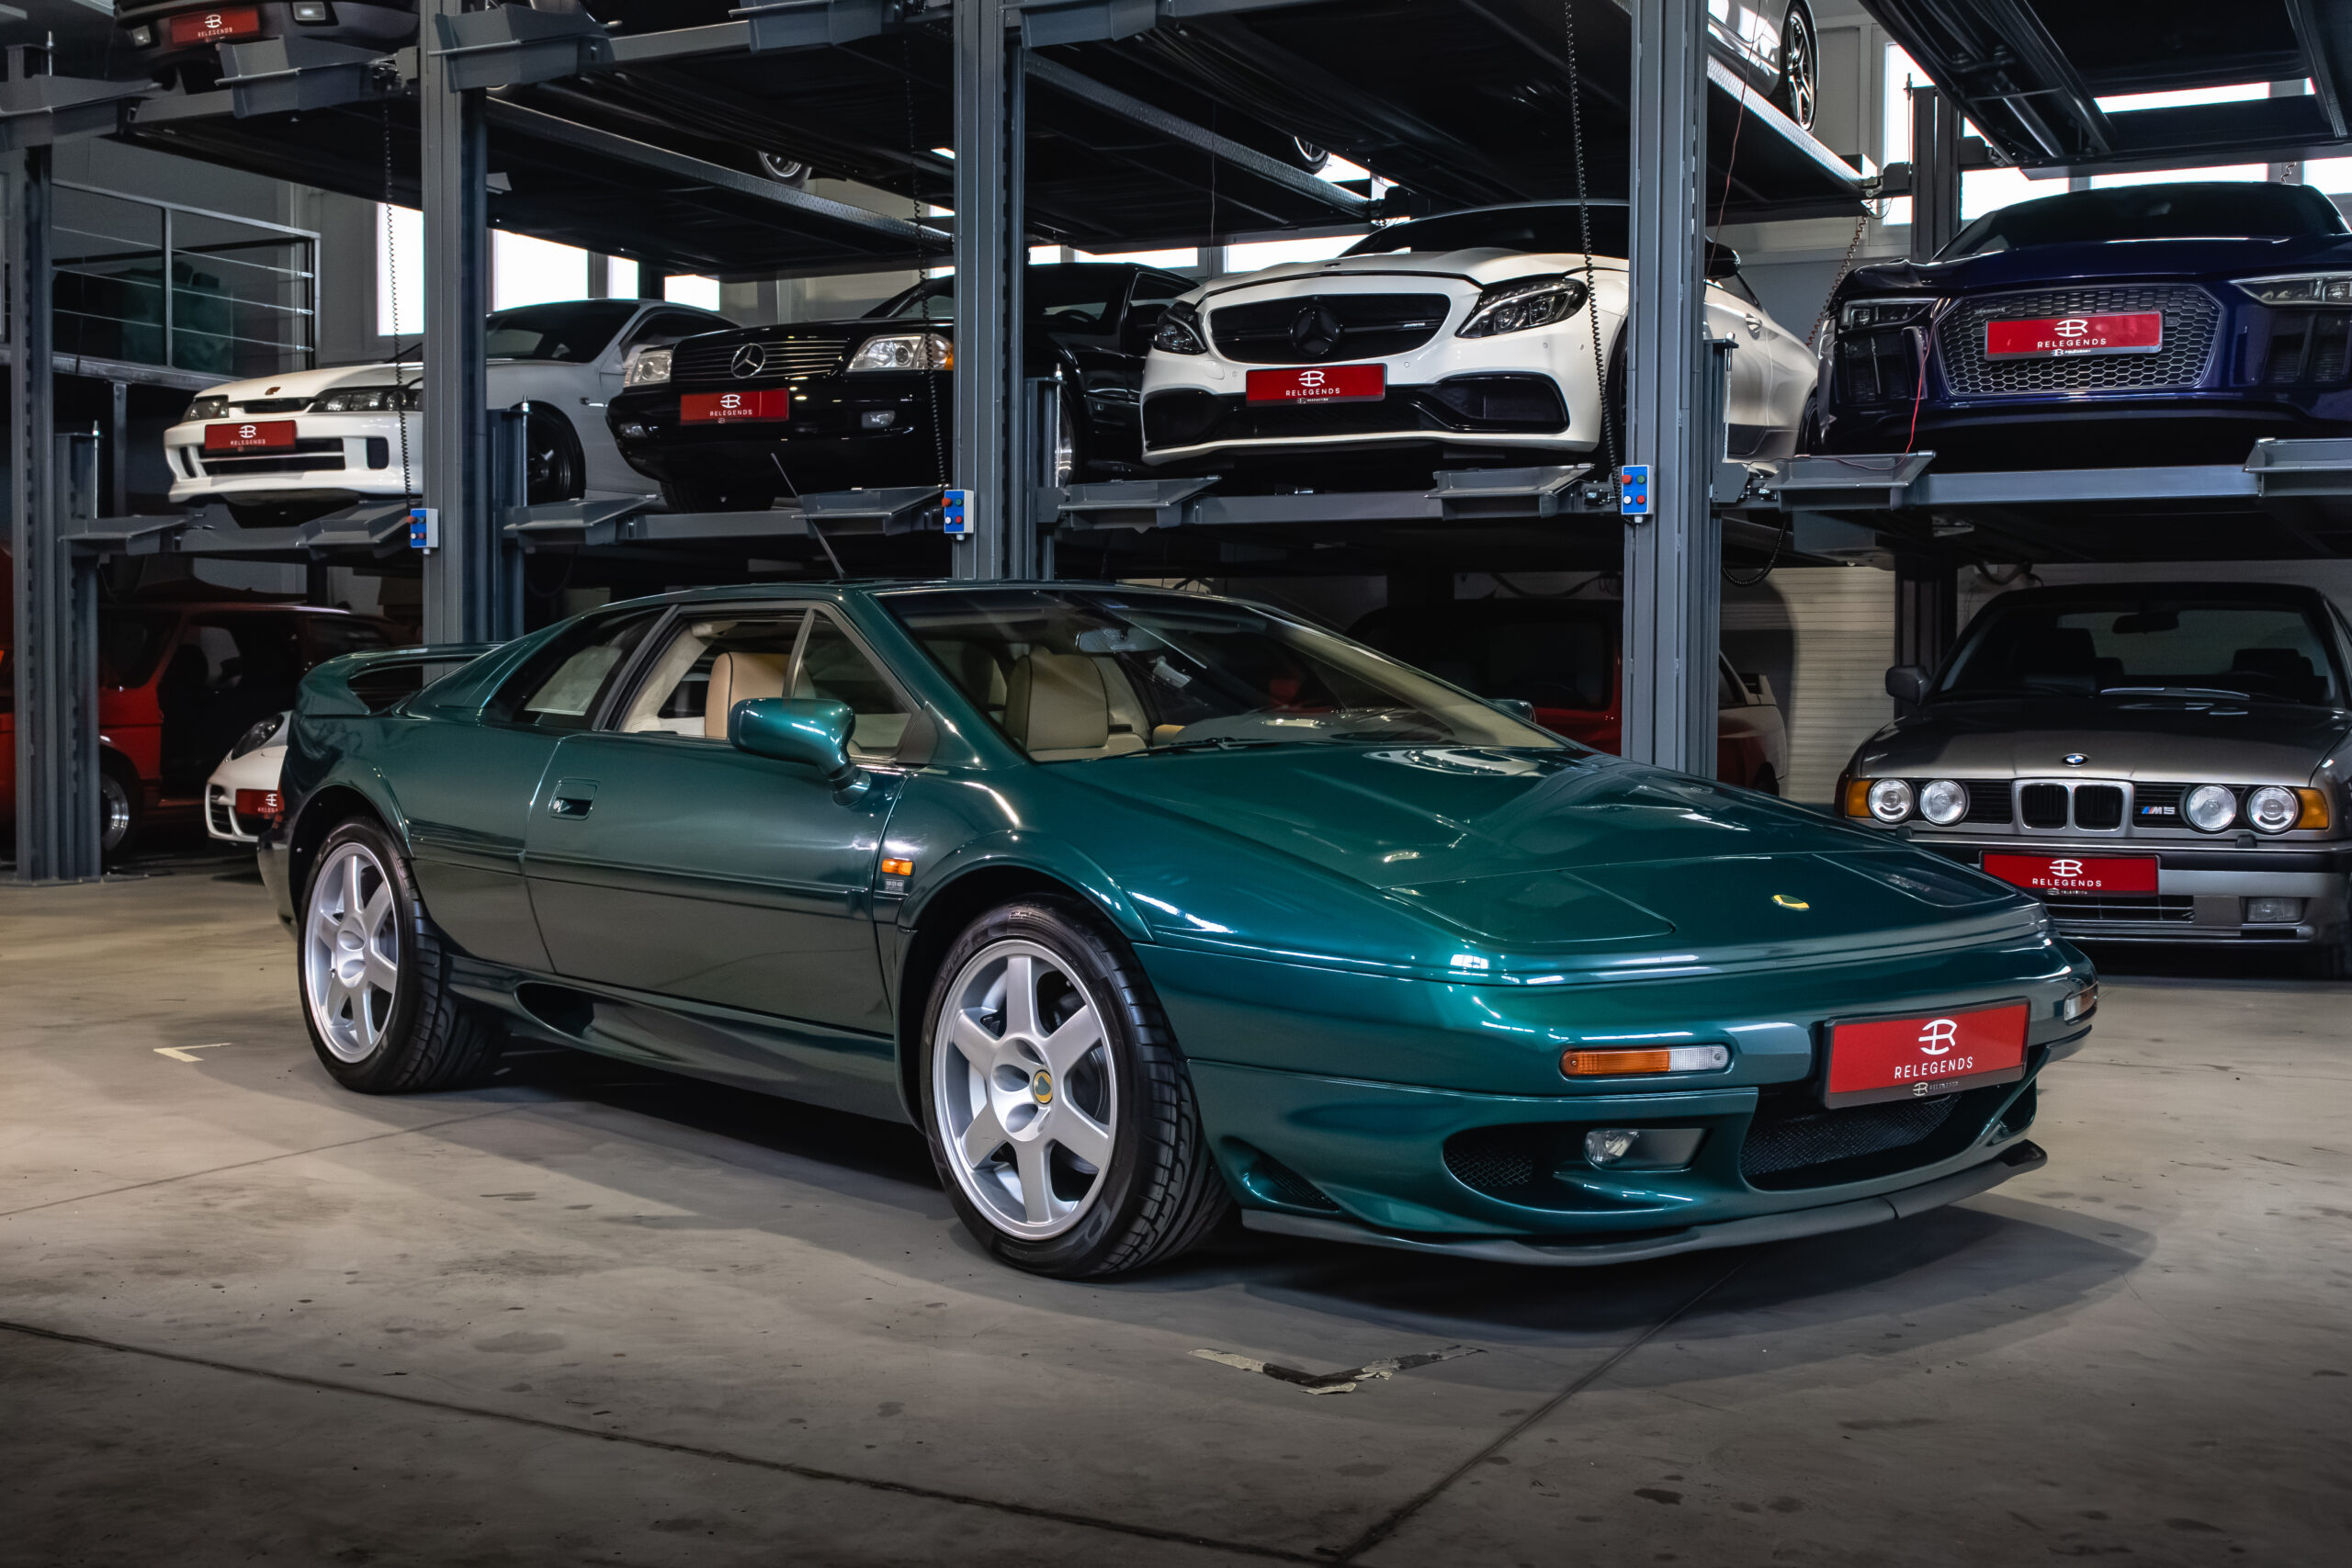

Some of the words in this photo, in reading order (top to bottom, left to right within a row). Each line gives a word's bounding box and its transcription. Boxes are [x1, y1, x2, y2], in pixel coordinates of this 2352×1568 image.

[2037, 337, 2107, 348] RELEGENDS
[1285, 388, 1340, 397] RELEGENDS
[2151, 807, 2176, 815] M5
[2032, 877, 2102, 887] RELEGENDS
[1894, 1056, 1973, 1079] RELEGENDS
